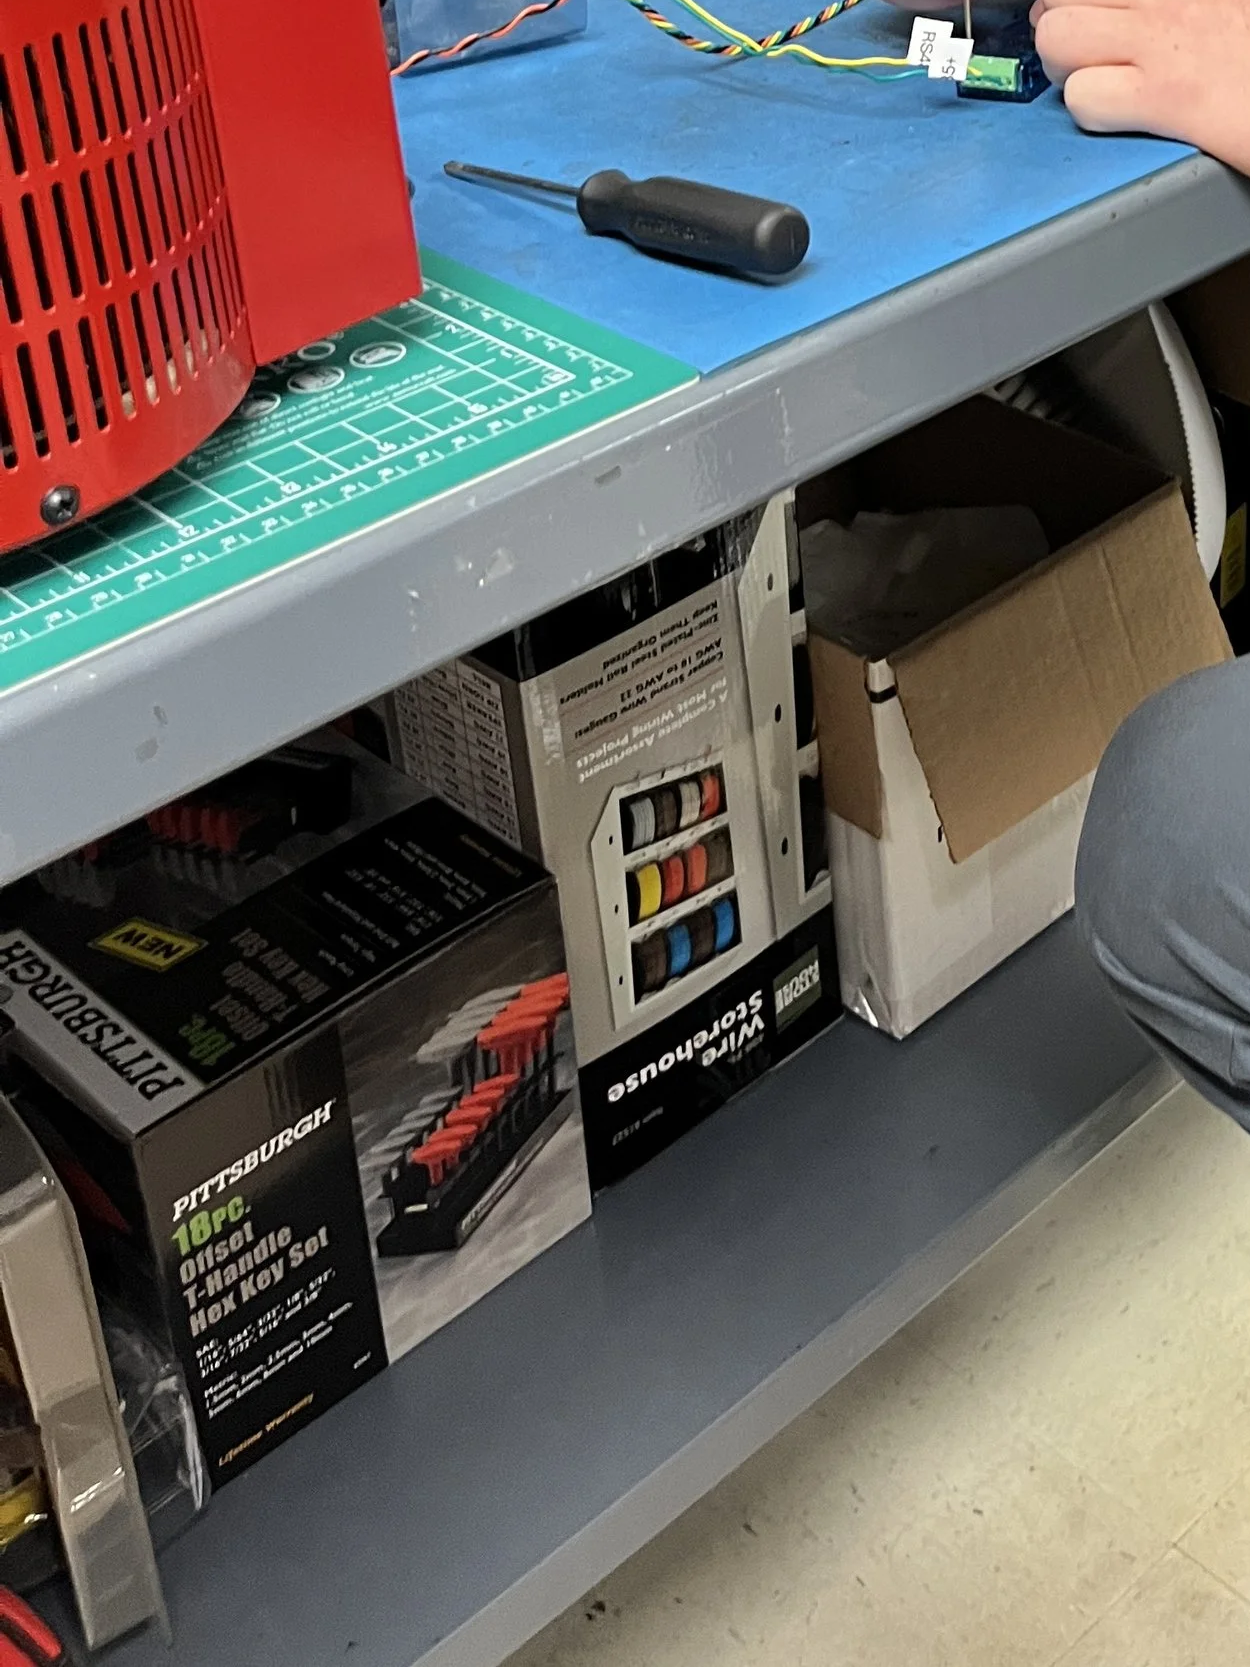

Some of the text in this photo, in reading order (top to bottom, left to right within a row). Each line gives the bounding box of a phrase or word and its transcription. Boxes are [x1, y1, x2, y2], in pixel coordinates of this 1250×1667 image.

[601, 599, 719, 671] Keep Them Organized
[696, 637, 723, 658] AWG
[636, 671, 665, 691] AWG
[649, 673, 686, 700] Strand
[666, 662, 680, 675] to
[632, 709, 675, 739] Wiring
[576, 733, 630, 769] Projects
[579, 733, 655, 784] Assortment
[112, 927, 183, 961] NEW
[0, 940, 187, 1101] PITTSBURGH
[701, 1014, 766, 1067] Wire
[606, 989, 764, 1104] Storehouse
[172, 1099, 335, 1222] PITTSBURGH
[179, 1220, 255, 1285] Offset
[182, 1225, 293, 1311] T-Handle
[189, 1224, 330, 1338] Hex Key Set
[218, 1429, 264, 1468] Lifetime
